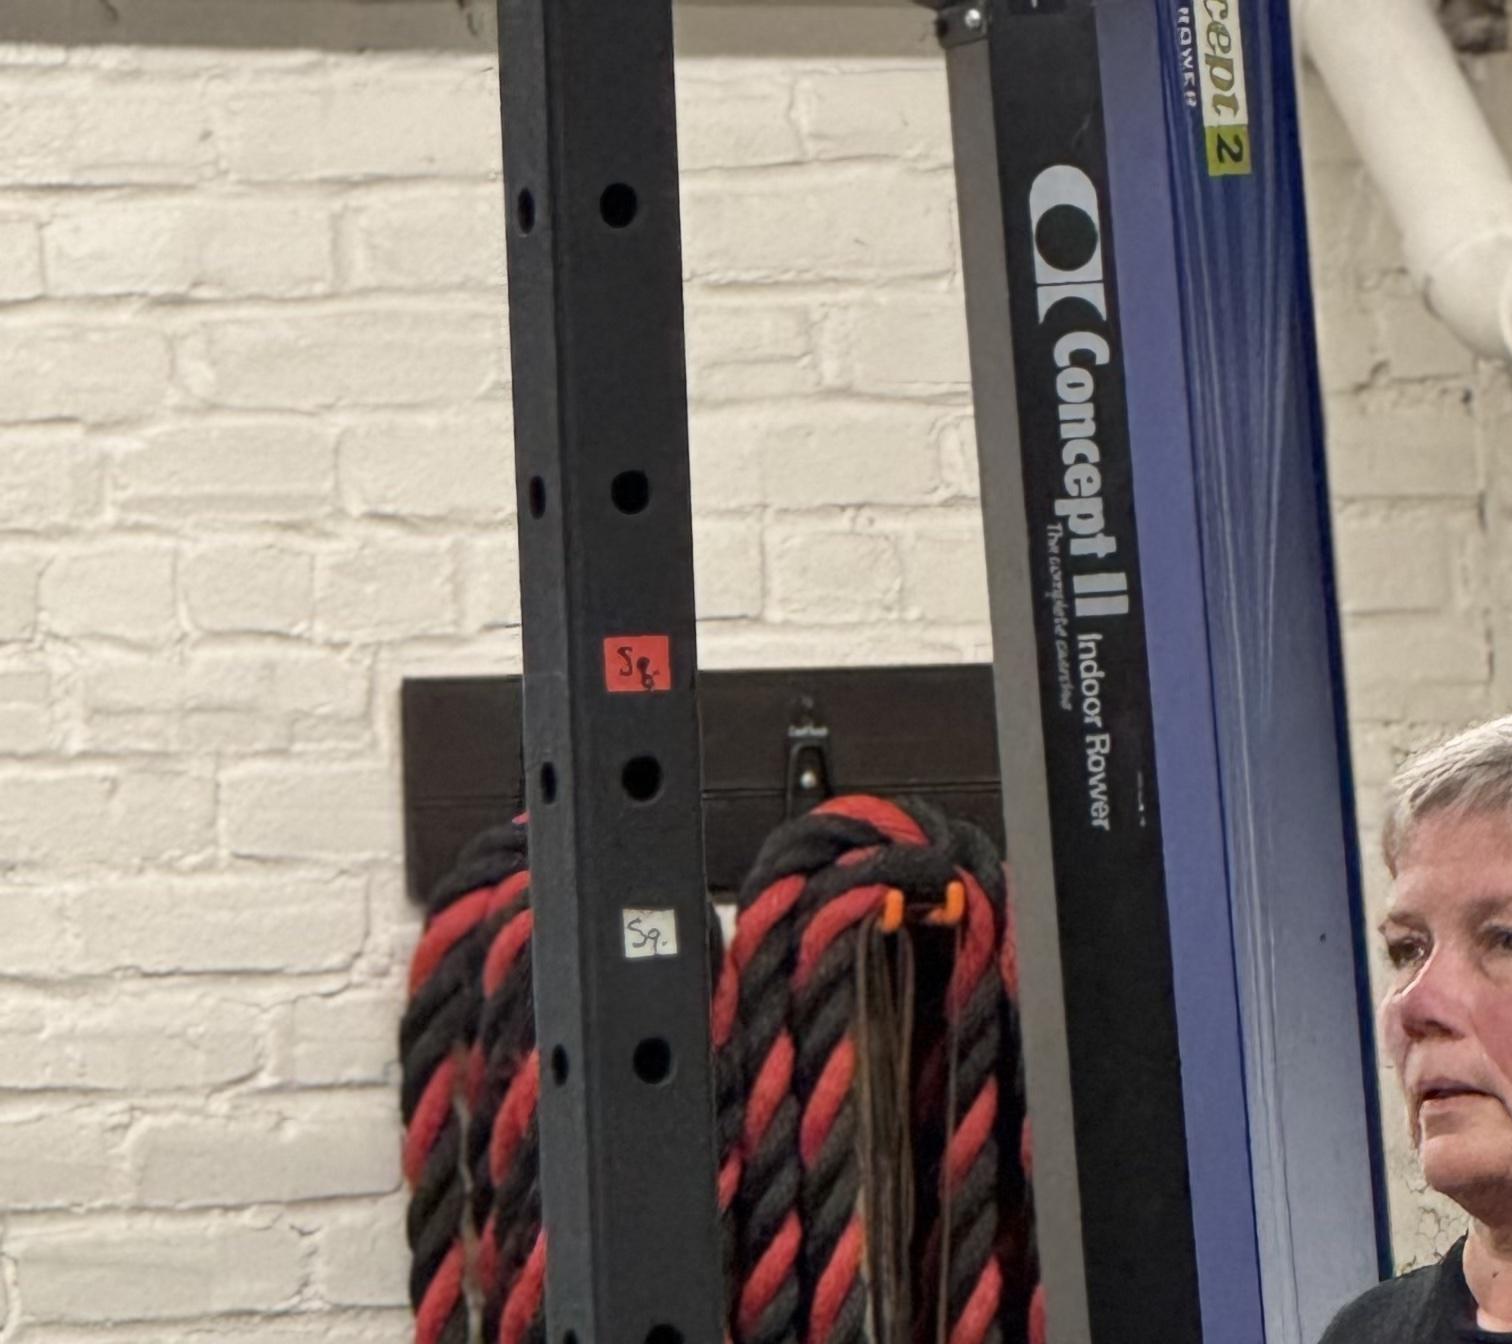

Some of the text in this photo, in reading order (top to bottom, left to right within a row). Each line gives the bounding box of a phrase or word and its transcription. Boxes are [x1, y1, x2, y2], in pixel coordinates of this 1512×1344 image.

[1216, 132, 1244, 164] 2
[1053, 330, 1118, 559] Concept
[1076, 633, 1113, 831] Indoor Rower
